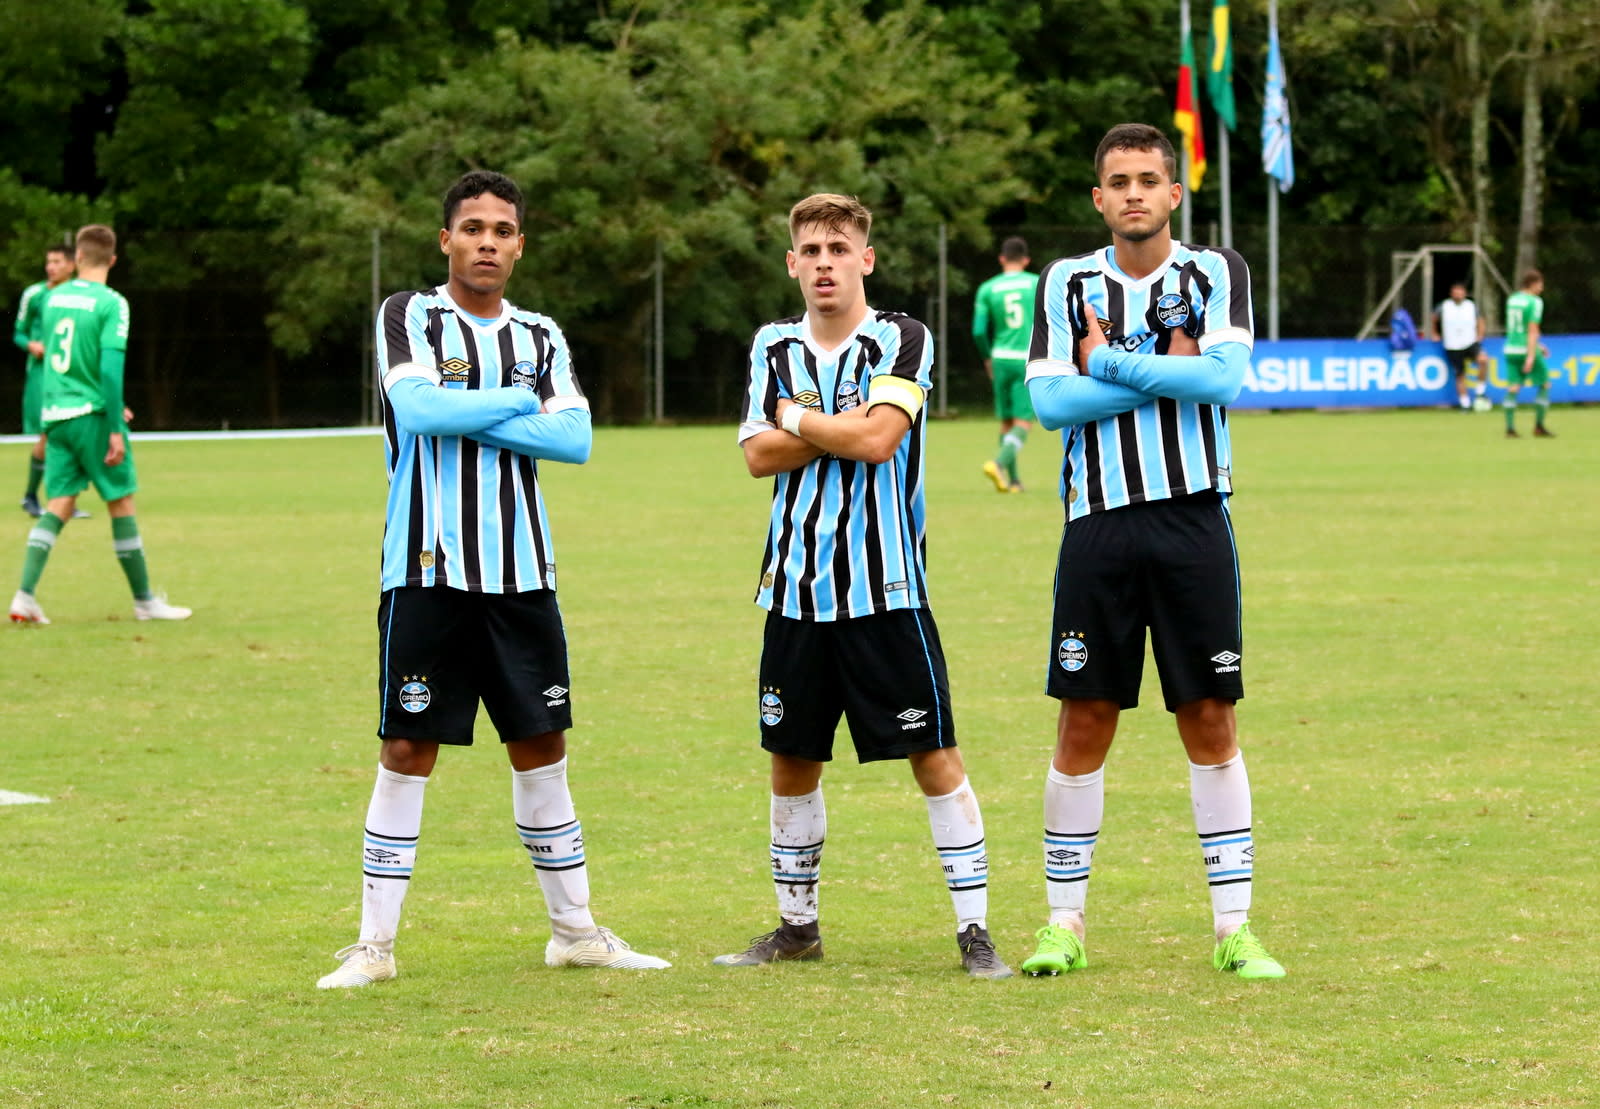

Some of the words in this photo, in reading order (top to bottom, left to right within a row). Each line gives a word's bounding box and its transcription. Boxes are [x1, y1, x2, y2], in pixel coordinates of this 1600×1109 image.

[1004, 293, 1023, 329] 5
[51, 318, 75, 374] 3
[1241, 351, 1448, 392] ASILEIRÃO
[1215, 665, 1240, 674] umbro
[547, 699, 566, 707] umbro
[902, 721, 926, 730] umbro
